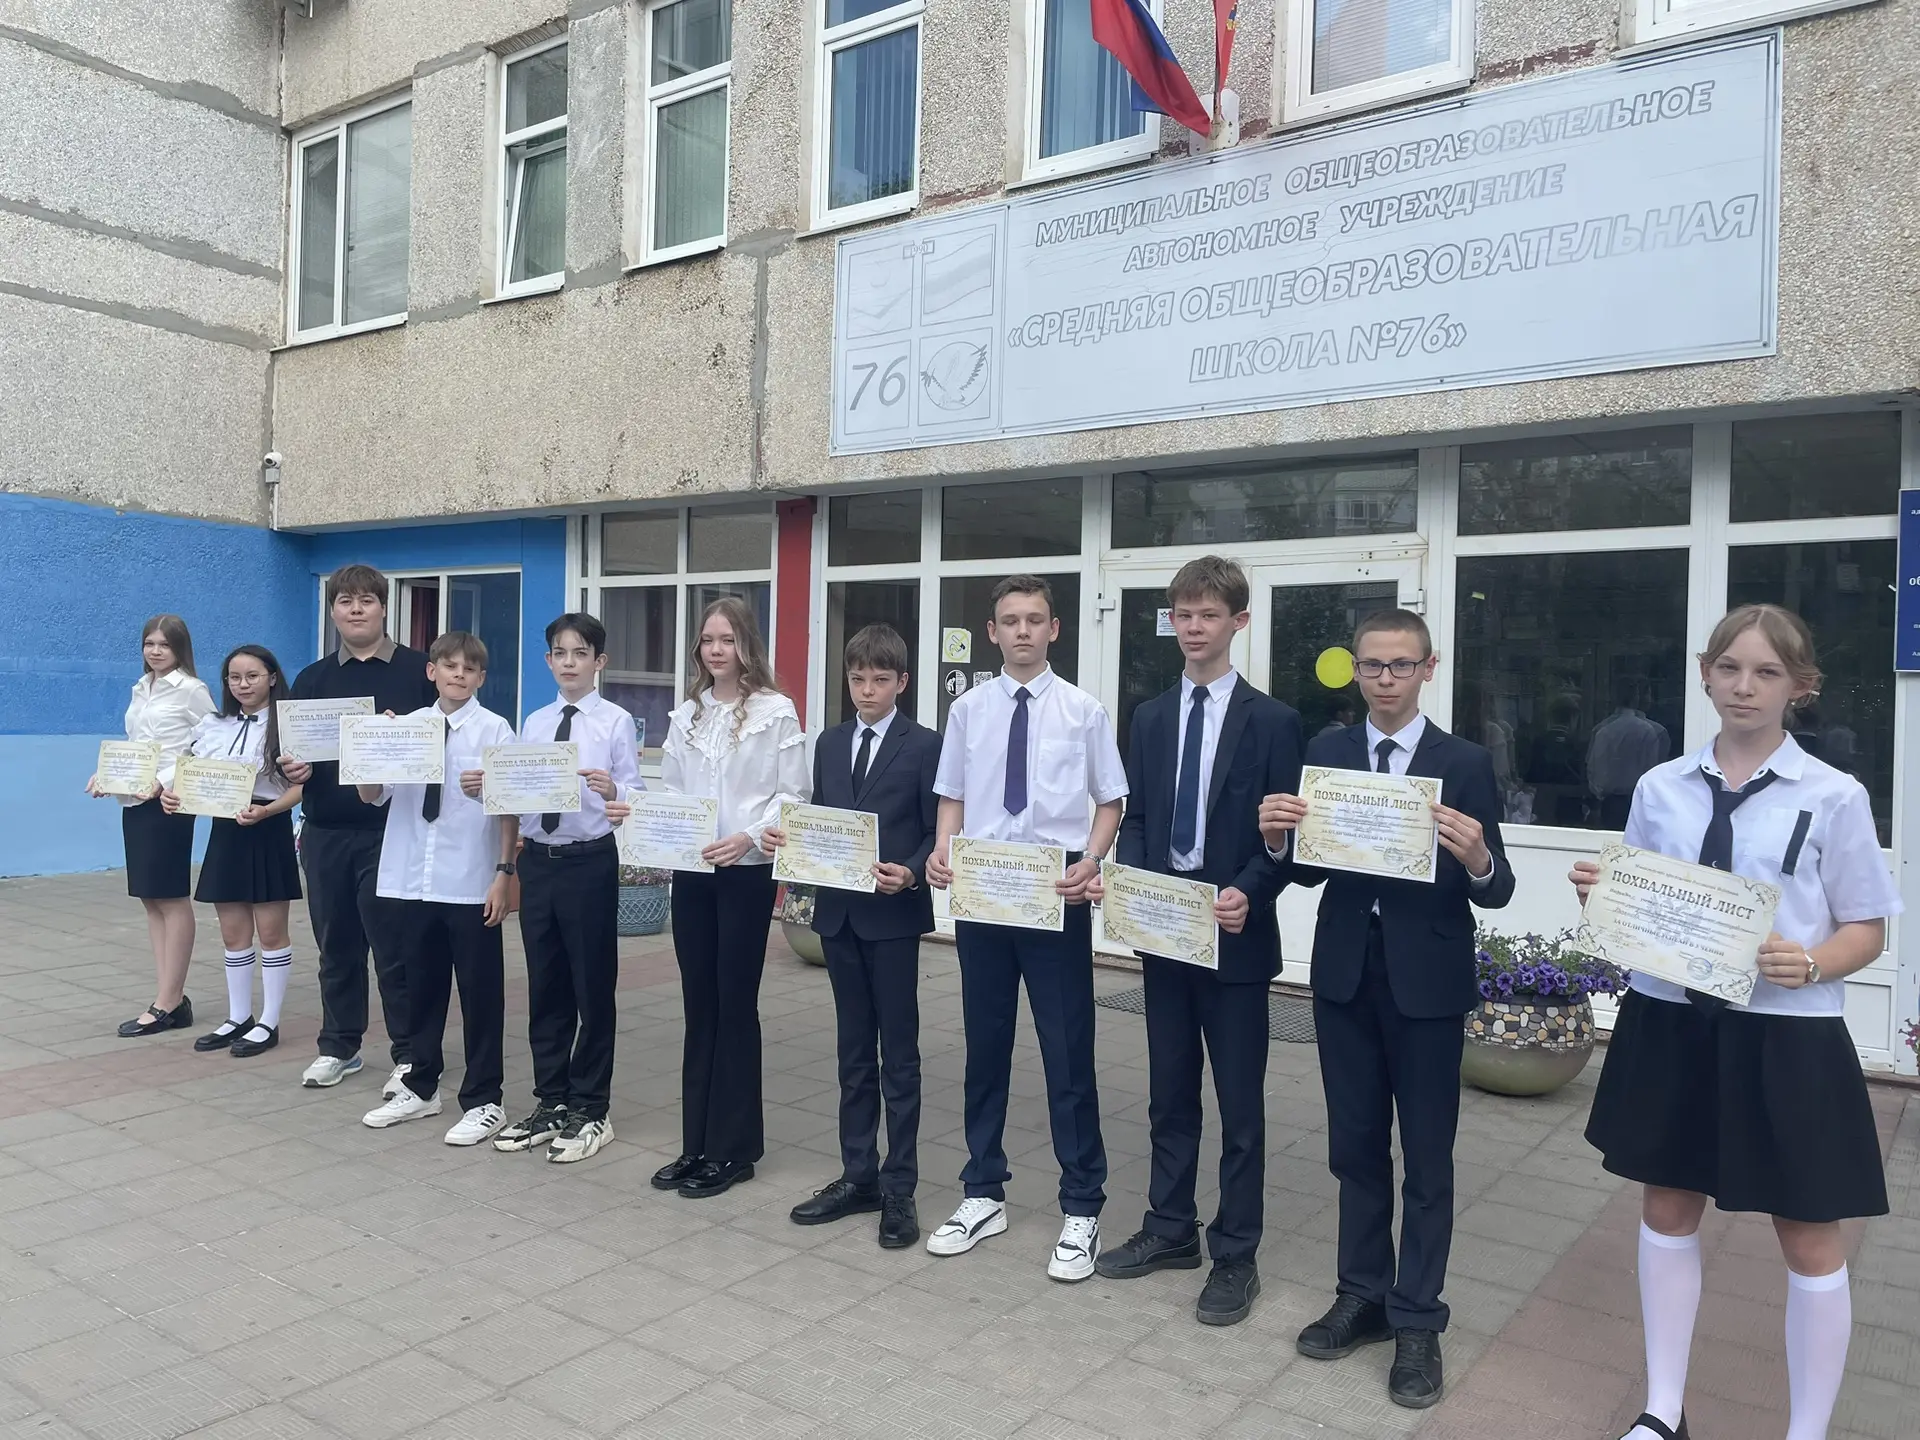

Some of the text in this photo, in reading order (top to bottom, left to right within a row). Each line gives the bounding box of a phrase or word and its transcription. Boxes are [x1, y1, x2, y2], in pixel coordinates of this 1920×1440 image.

[1036, 80, 1715, 247] МУНИЦИПАЛЬНОЕ ОБЩЕОБРАЗОВАТЕЛЬНОЕ
[1123, 163, 1566, 272] АВТОНОМНОЕ УЧРЕЖДЕНИЕ
[1007, 194, 1758, 348] «СРЕДНЯЯ ОБЩЕОБРАЗОВАТЕЛЬНАЯ
[1189, 313, 1467, 384] ШКОЛА №76»
[849, 355, 908, 411] 76
[1314, 789, 1421, 811] ПОХВАЛЬНЫЙ ЛИСТ
[788, 820, 866, 838] ПОХВАЛЬНЫЙ ЛИСТ
[962, 856, 1051, 873] ПОХВАЛЬНЫЙ ЛИСТ
[1114, 883, 1176, 904] ПОХВАЛЬНЫЙ
[1177, 898, 1202, 910] ЛИСТ
[1612, 870, 1712, 908] ПОХВАЛЬНЫЙ
[1713, 900, 1755, 920] ЛИСТ
